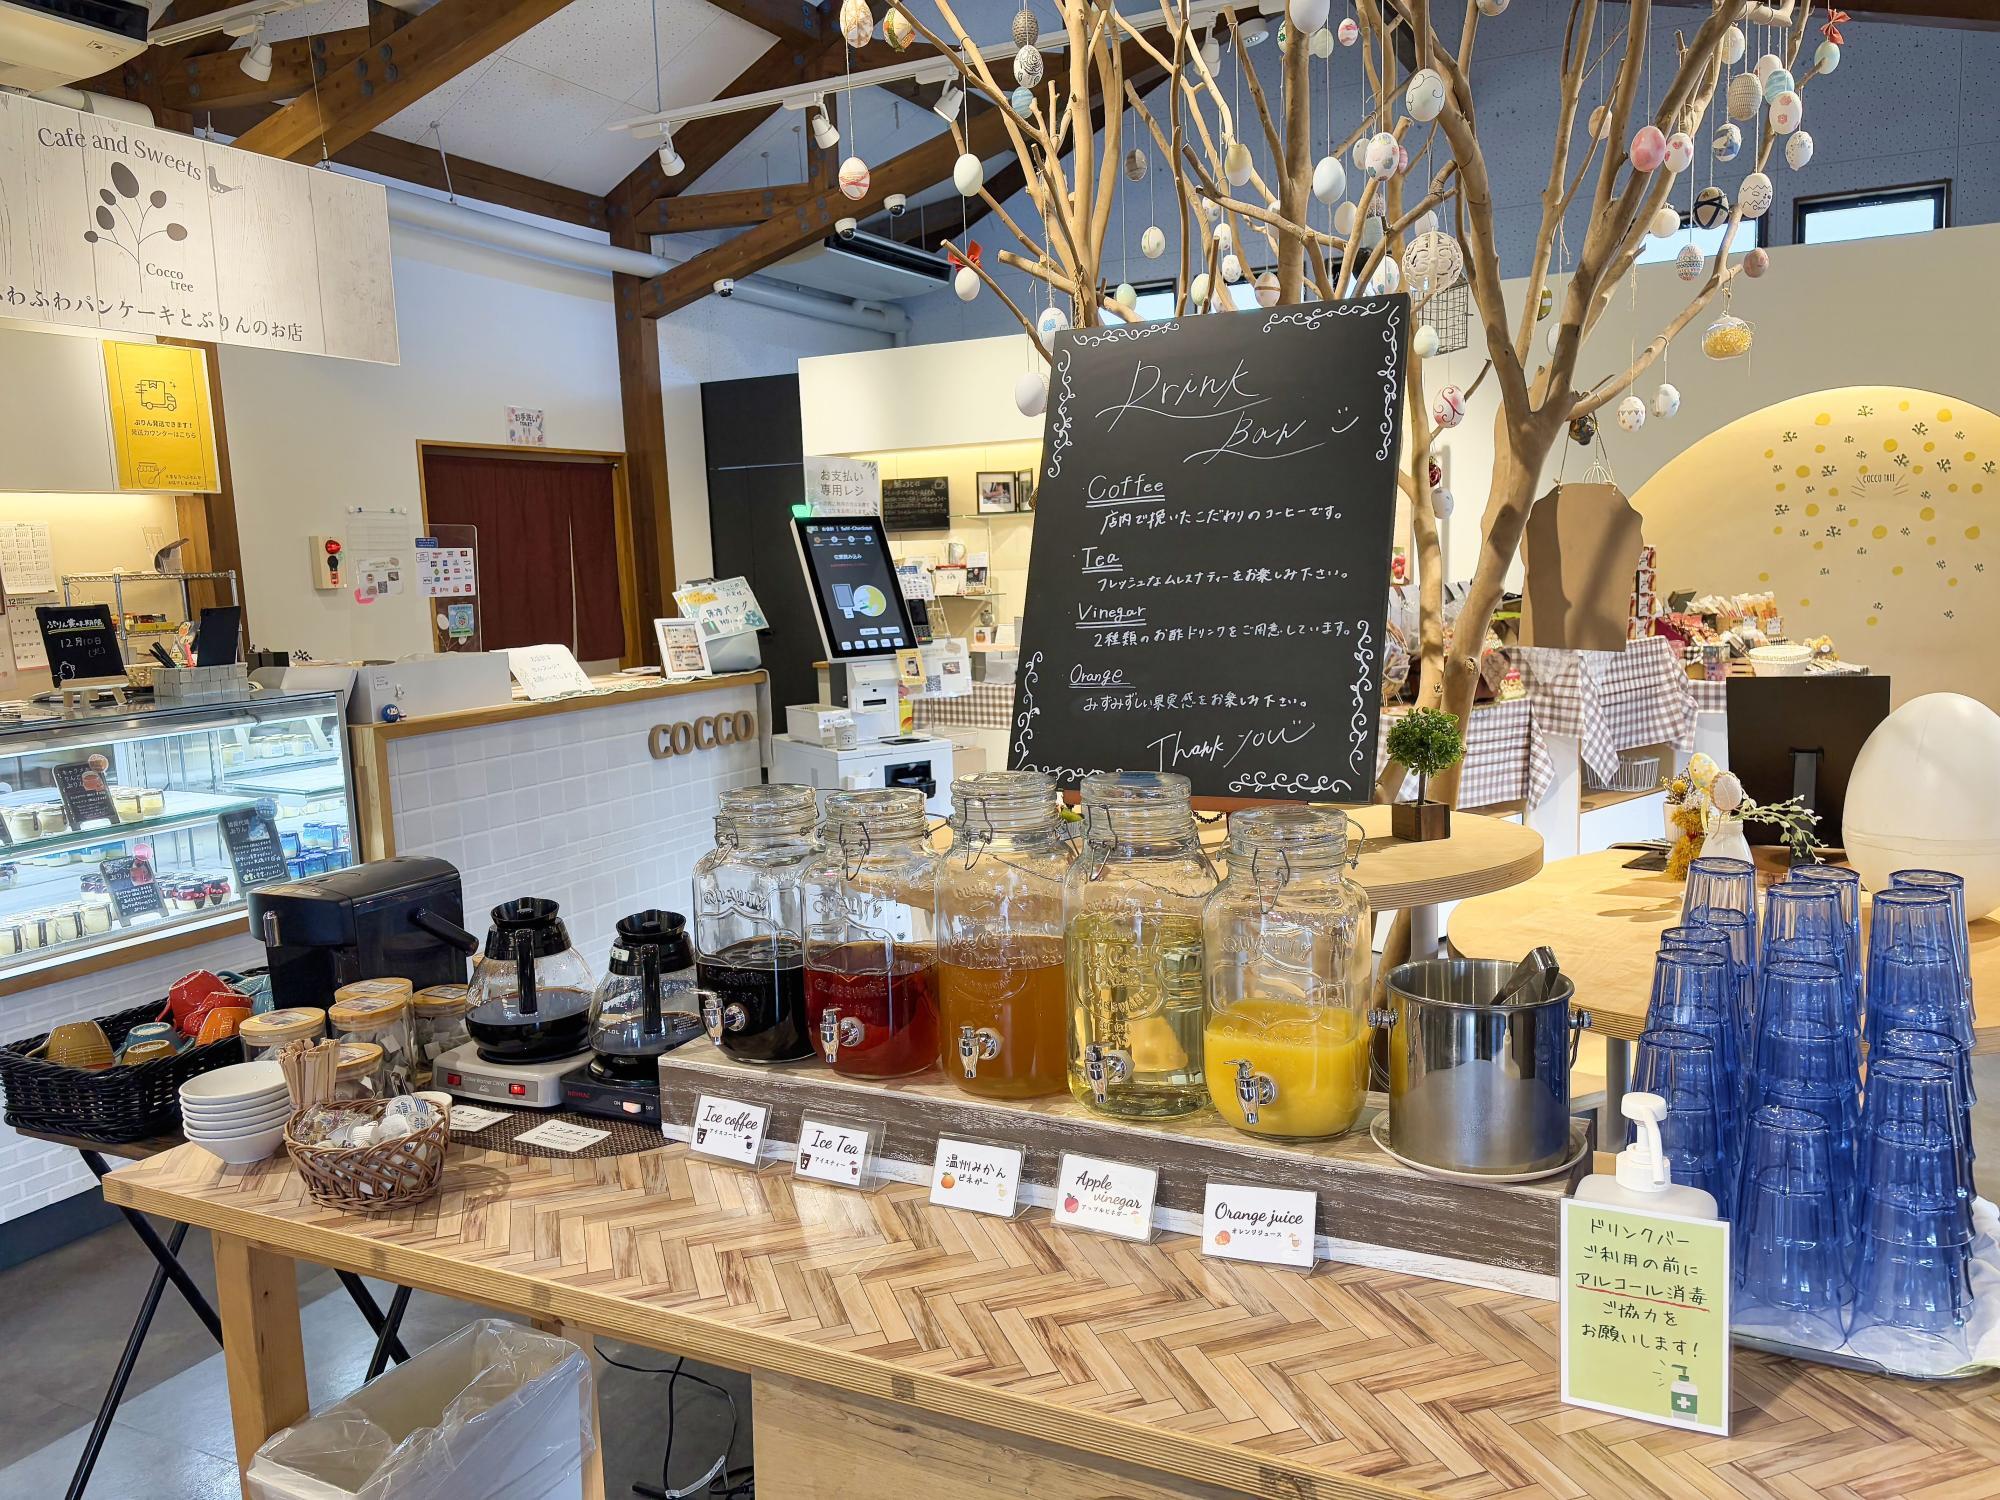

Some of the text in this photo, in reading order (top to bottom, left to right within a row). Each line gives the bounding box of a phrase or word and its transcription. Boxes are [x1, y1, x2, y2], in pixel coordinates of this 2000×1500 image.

[38, 127, 202, 182] Cafe and Sweets
[145, 262, 185, 280] Cocco
[170, 278, 194, 293] tree
[0, 285, 303, 342] わふわパンケーキとぷりんのお店
[1108, 358, 1260, 433] Drink
[131, 429, 197, 439] 発送カウンターはこちら
[820, 470, 864, 482] お支払い
[1088, 473, 1164, 500] Coffee
[820, 483, 865, 497] 専用レジ
[1100, 505, 1343, 535] 店内で挽いたこだわりのコーヒーです。
[1082, 546, 1120, 568] Tea
[1097, 567, 1349, 592] フレッシュなムレスナティーをお楽しみ下さい。
[8, 598, 16, 606] 12
[1078, 602, 1147, 622] Vinegar
[1093, 620, 1351, 648] 2種類のお酢ドリンクをご用意しています。
[1070, 663, 1123, 685] Orange
[1083, 690, 1308, 712] みずみずしい果実感をお楽しみ下さい。
[649, 710, 755, 760] COCCO
[1147, 731, 1224, 772] Thank
[703, 1105, 758, 1133] Ice coffee
[709, 1128, 743, 1139] アイスコーヒー
[811, 1130, 859, 1155] Ice Tea
[814, 1156, 846, 1167] アイスティー
[945, 1153, 1006, 1179] 温州みかん
[958, 1173, 989, 1186] ビネガー
[1075, 1170, 1113, 1191] Apple
[1081, 1204, 1128, 1217] アップルビネガー
[1093, 1191, 1143, 1210] vinegar
[1215, 1202, 1304, 1227] Orange juice
[1232, 1228, 1282, 1238] オレンジジュース
[1590, 1218, 1690, 1246] ドリンクバー
[1583, 1245, 1698, 1276] ご利用の前に
[1575, 1272, 1708, 1306] アルコール消毒
[1603, 1300, 1678, 1327] ご協力を
[1581, 1323, 1699, 1358] お願いします!
